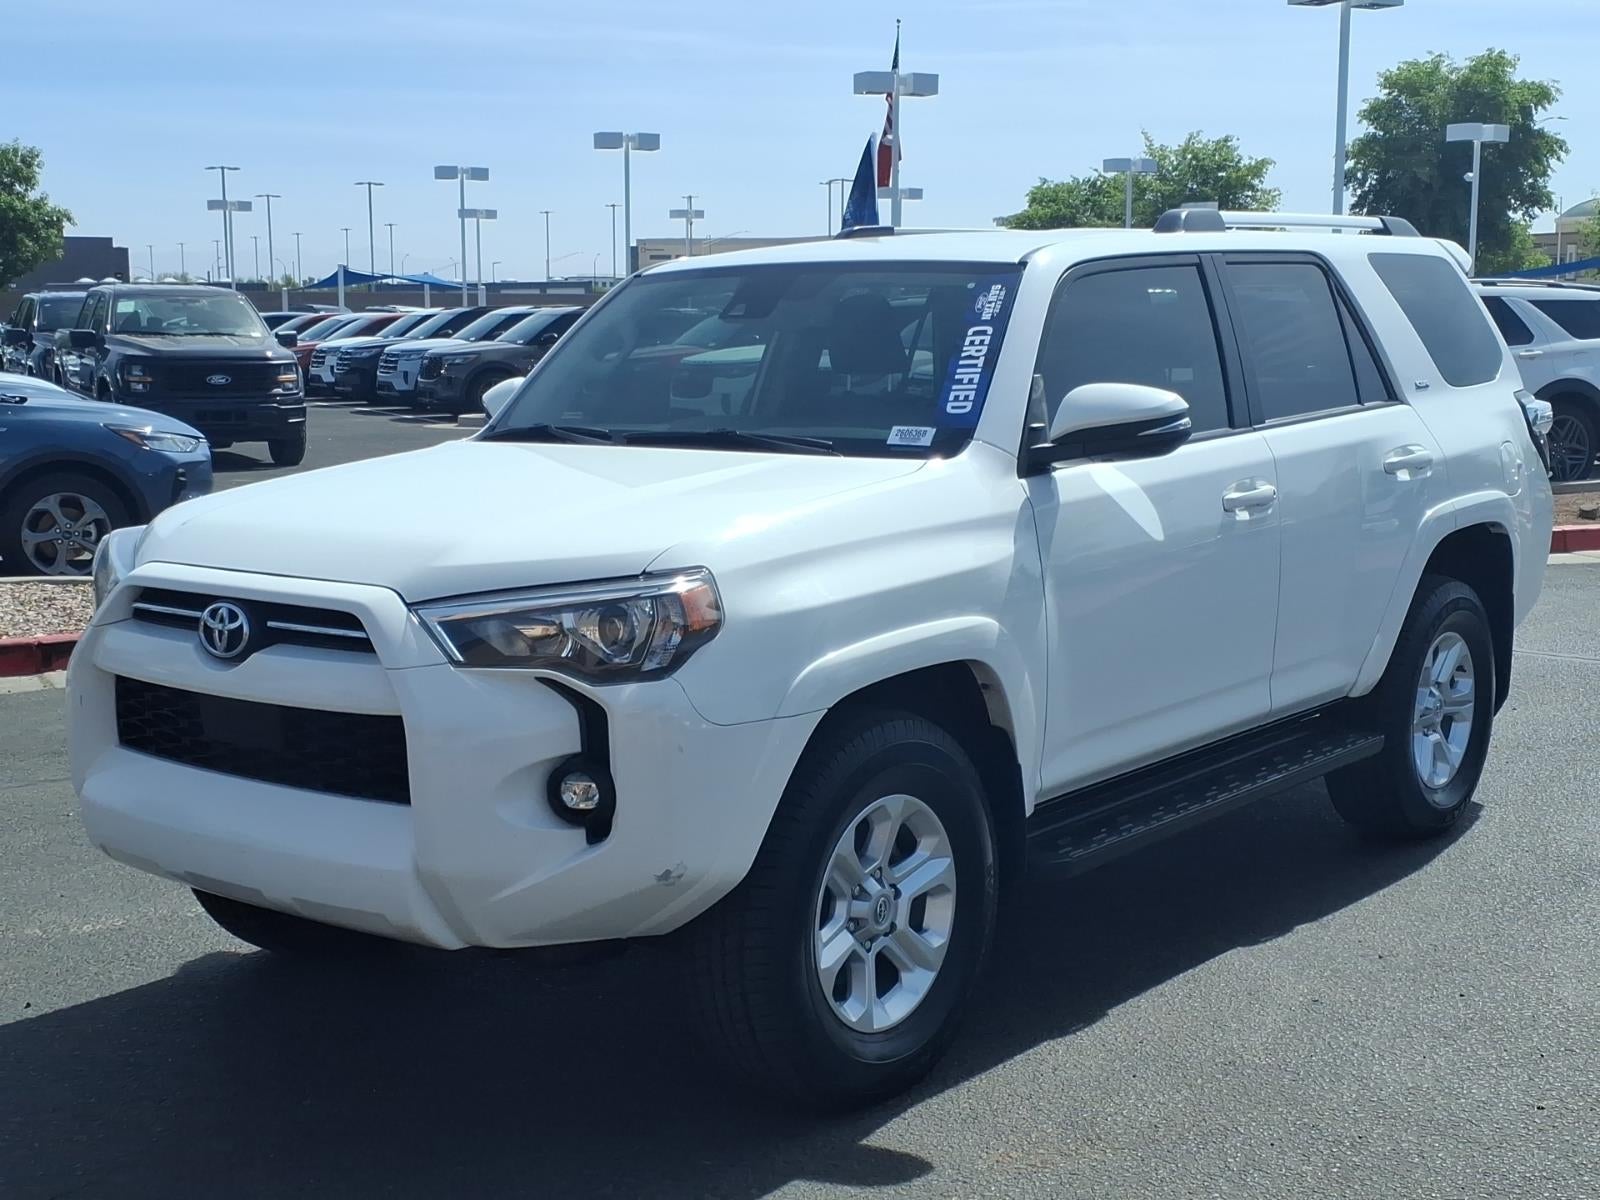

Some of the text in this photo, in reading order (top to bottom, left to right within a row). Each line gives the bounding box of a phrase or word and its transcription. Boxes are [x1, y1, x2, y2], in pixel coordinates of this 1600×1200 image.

[981, 284, 1002, 320] SAN TAN
[209, 375, 228, 384] Ford
[946, 326, 993, 414] CERTIFIED
